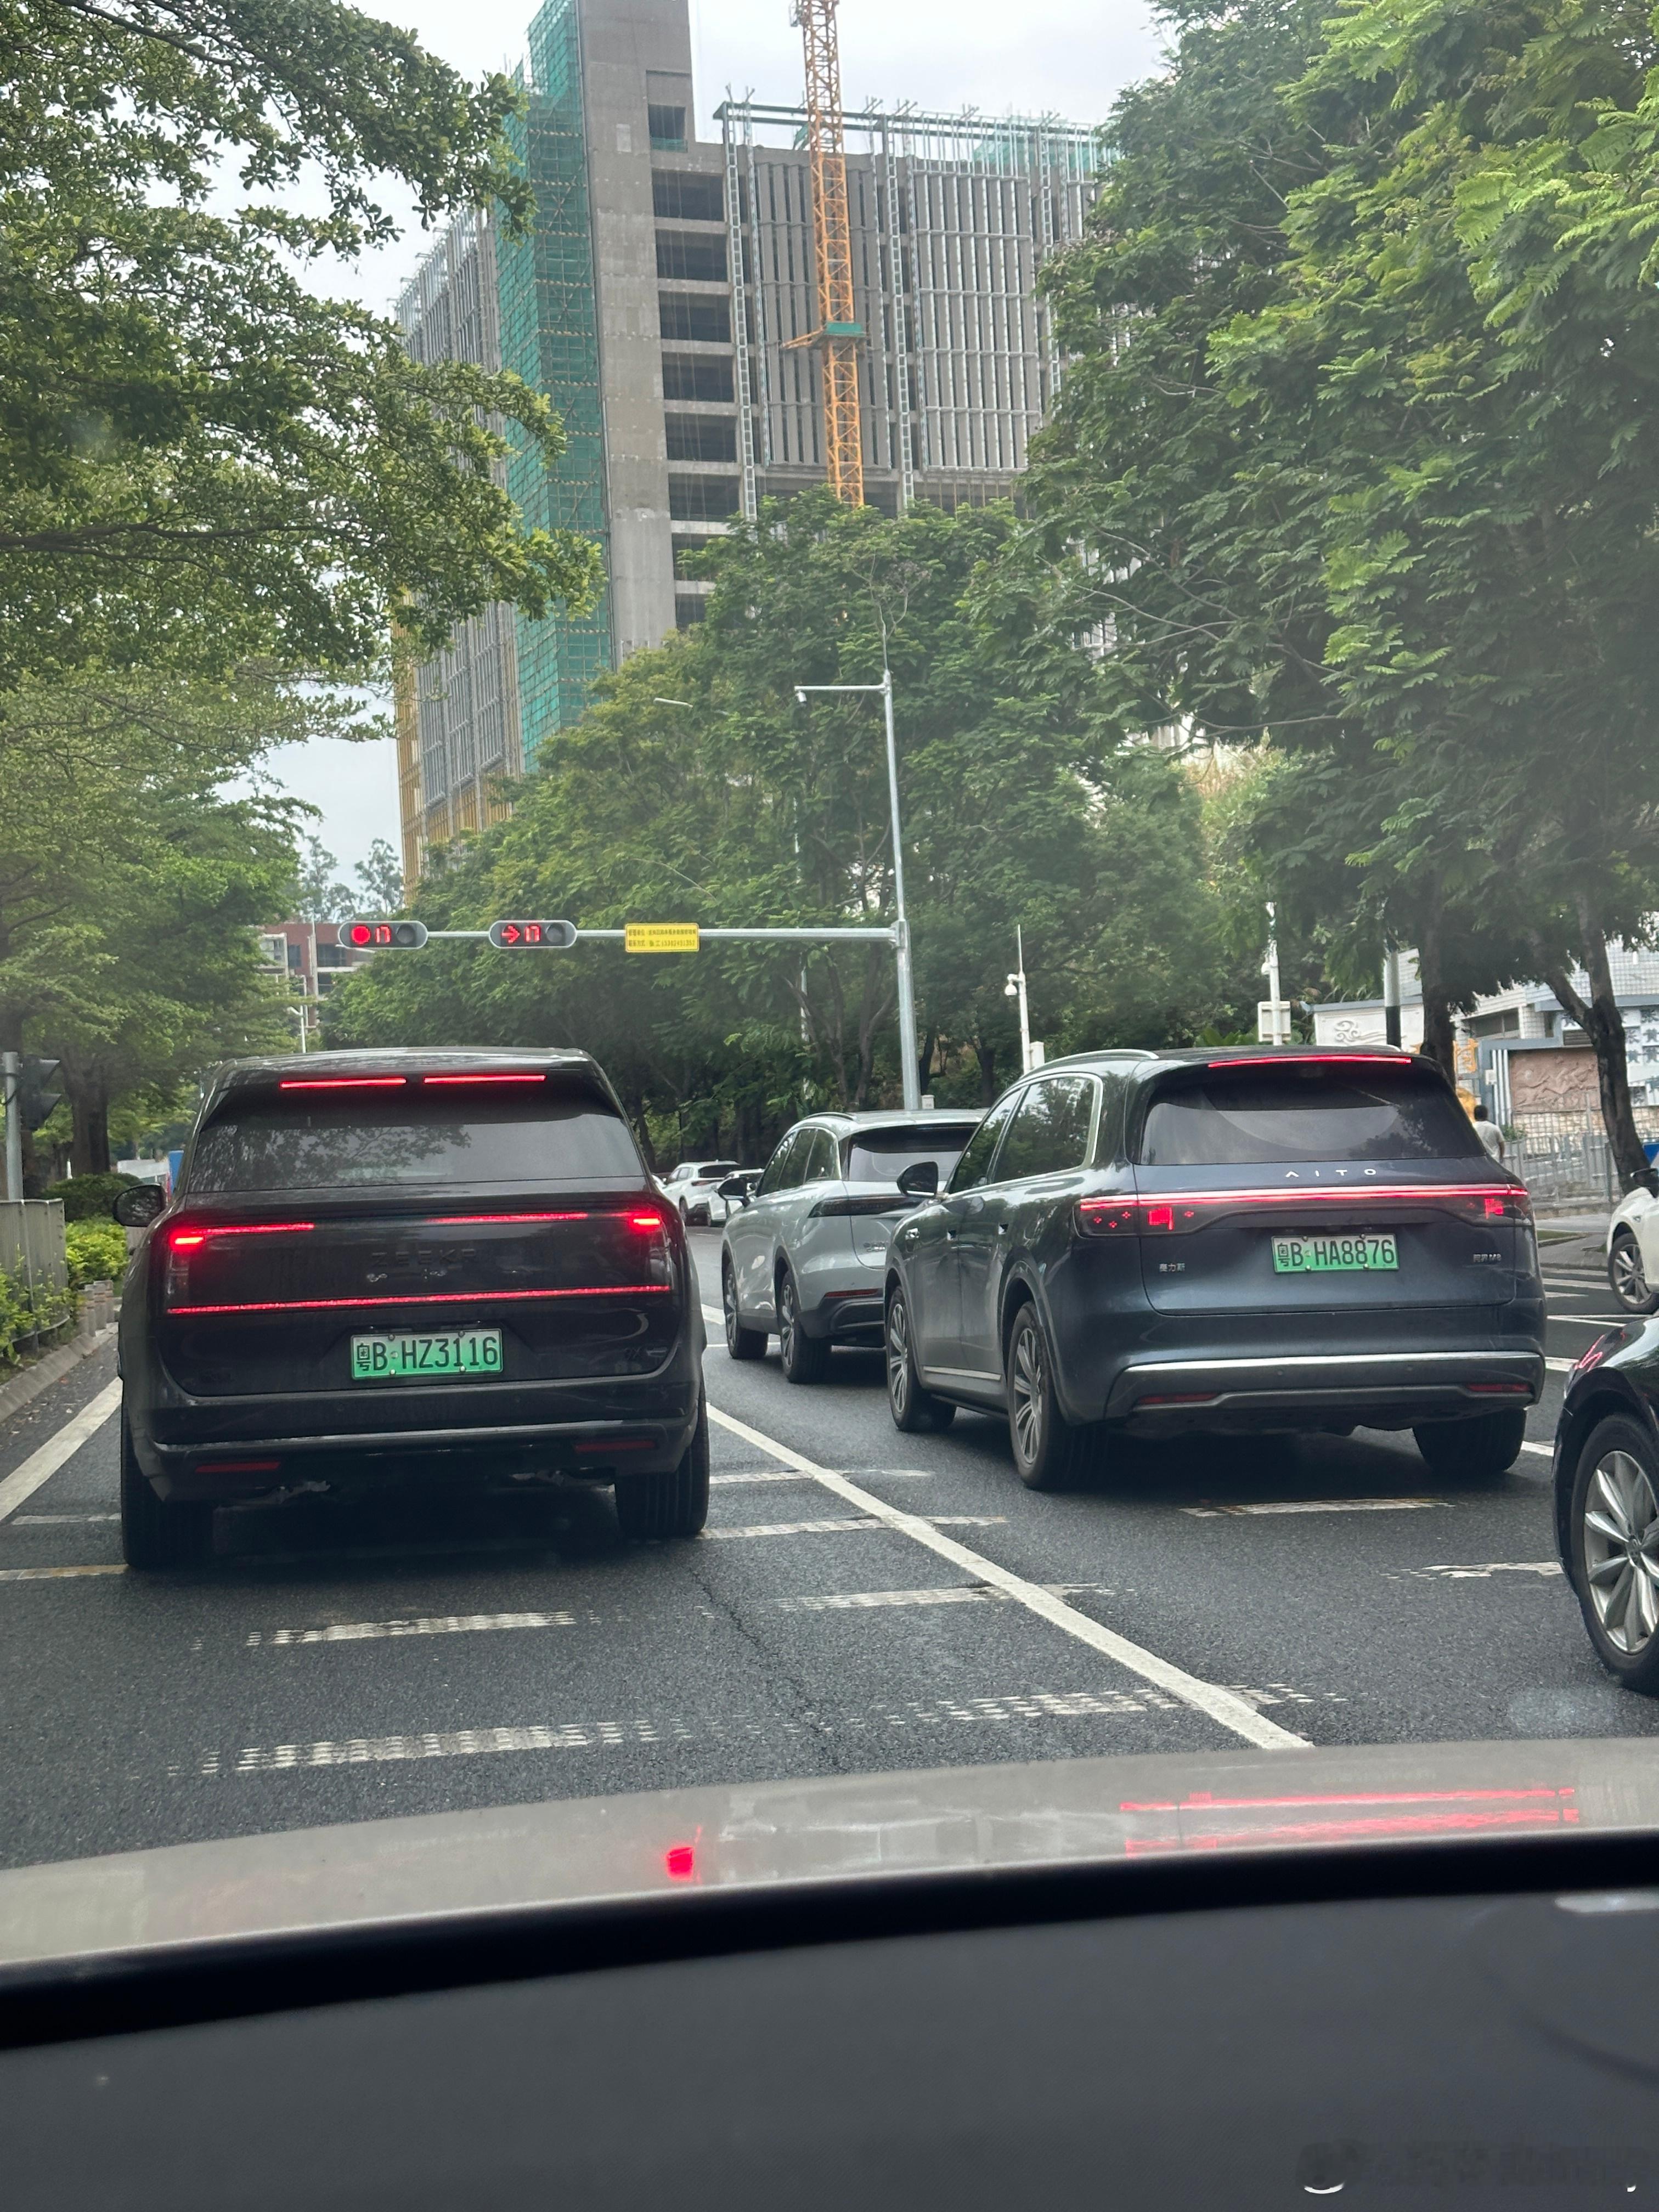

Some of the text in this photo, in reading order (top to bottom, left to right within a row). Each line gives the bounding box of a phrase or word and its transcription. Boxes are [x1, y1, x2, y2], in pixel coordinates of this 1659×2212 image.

[375, 926, 391, 943] 17
[524, 925, 540, 943] 17
[1285, 1168, 1377, 1178] AITO
